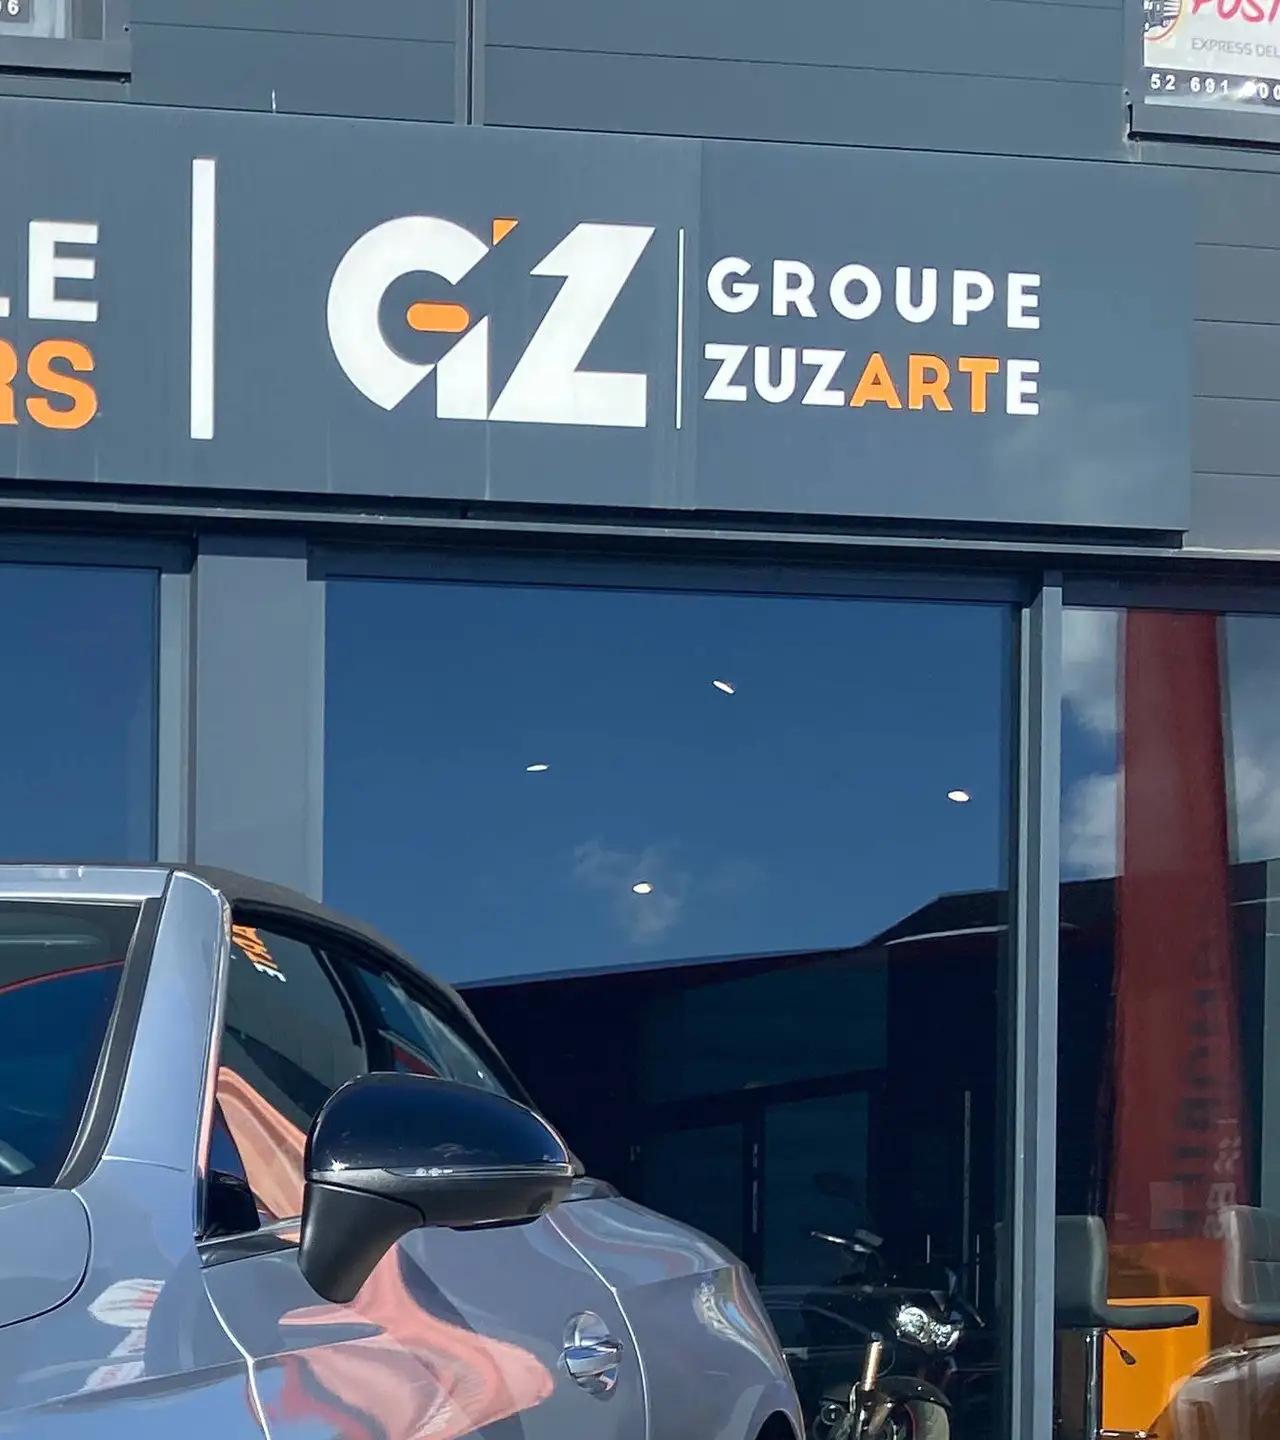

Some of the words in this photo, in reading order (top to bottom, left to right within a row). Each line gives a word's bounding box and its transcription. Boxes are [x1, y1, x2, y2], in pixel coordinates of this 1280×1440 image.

[1192, 38, 1252, 55] EXPRESS
[706, 256, 1042, 330] GROUPE
[703, 343, 1041, 416] ZUZARTE
